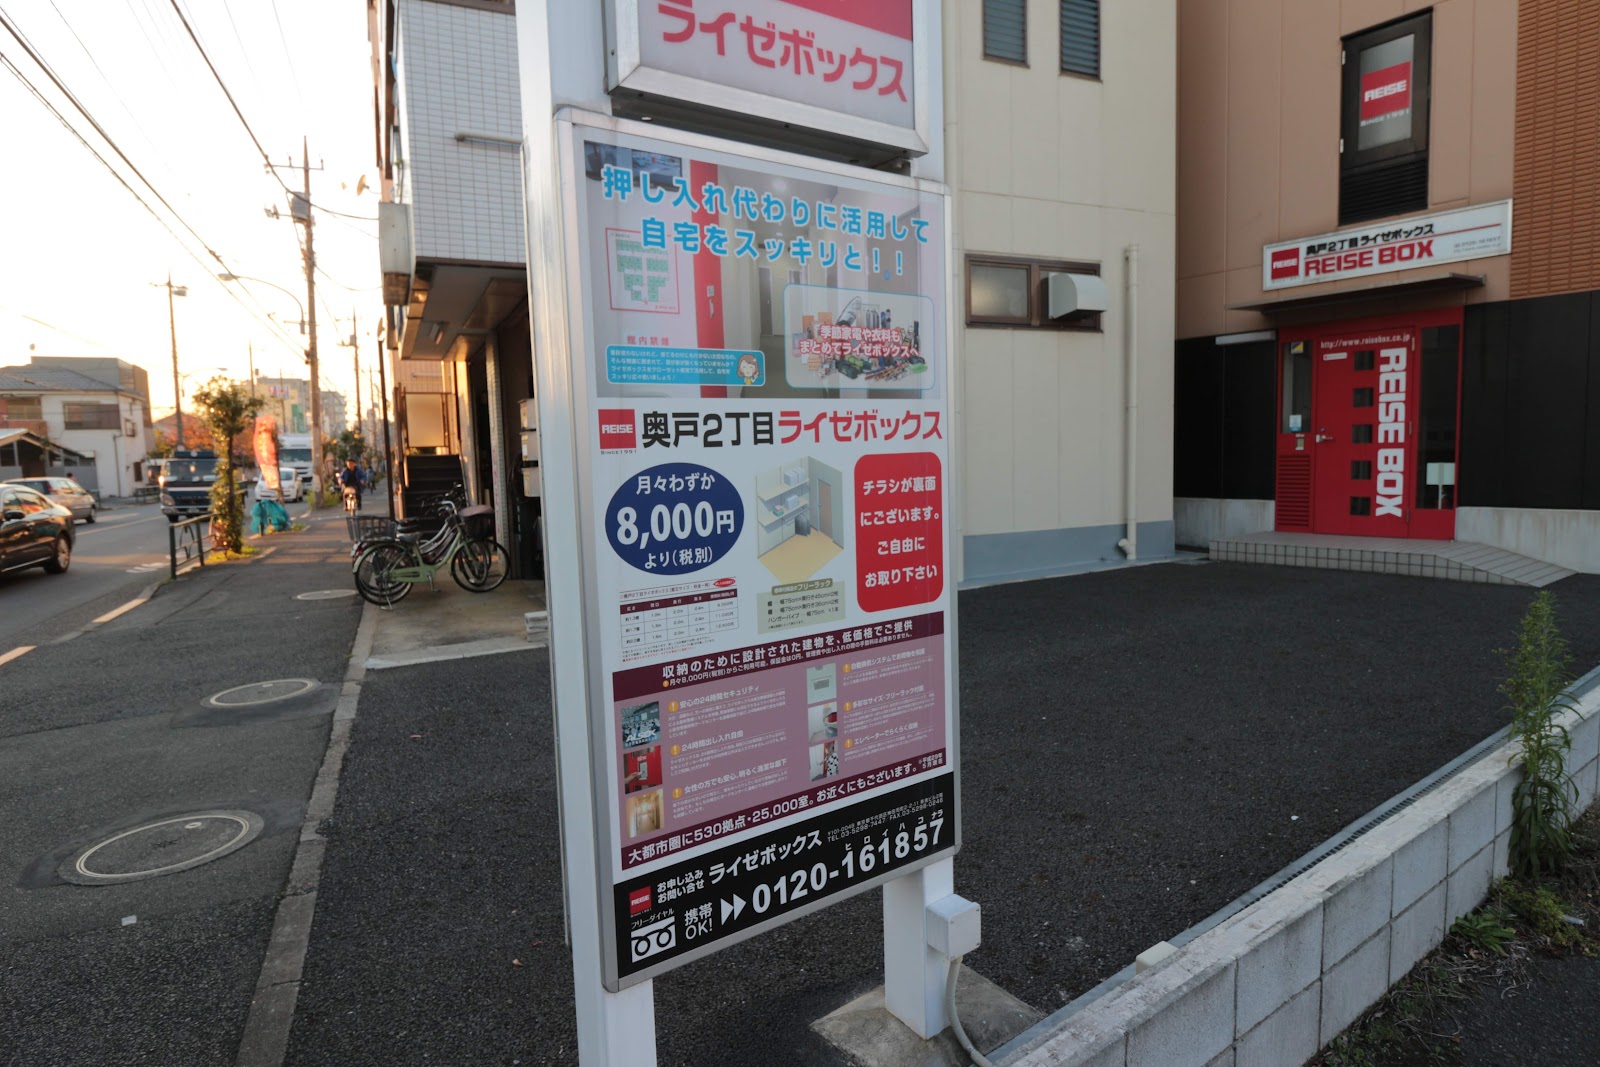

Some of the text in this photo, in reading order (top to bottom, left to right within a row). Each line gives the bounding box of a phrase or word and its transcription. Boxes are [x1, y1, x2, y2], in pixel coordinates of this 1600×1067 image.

[658, 0, 907, 102] ライゼボックス
[1364, 79, 1408, 102] REISE
[602, 166, 930, 243] 押し入れ代わりに活用して
[1273, 257, 1298, 269] REISE
[1304, 253, 1374, 277] REISE
[1378, 240, 1433, 265] BOX
[800, 340, 920, 358] まとめてライゼボックスへ
[601, 423, 634, 434] REISE
[1375, 347, 1408, 517] REISE BOX
[636, 472, 716, 495] 月々わずか
[862, 476, 937, 495] チラシが裏面
[616, 500, 735, 550] 8,000円
[860, 506, 940, 526] にございます。
[877, 537, 926, 556] ご自由に
[865, 565, 938, 588] お取り下さい
[662, 620, 913, 679] 収納のために設計された建物を、低価格でご提供
[679, 685, 760, 710] 安心の24時間セキュリティ
[625, 729, 657, 743] ALSOK
[681, 730, 744, 752] 24時間出し入れ自由
[708, 829, 823, 885] ライゼボックス
[752, 817, 945, 914] 0120-161857
[657, 869, 704, 893] お申し込み
[657, 879, 705, 904] お問い合せ
[631, 908, 675, 930] フリーダイヤル
[684, 902, 713, 927] 携帯
[685, 918, 713, 940] OK!
